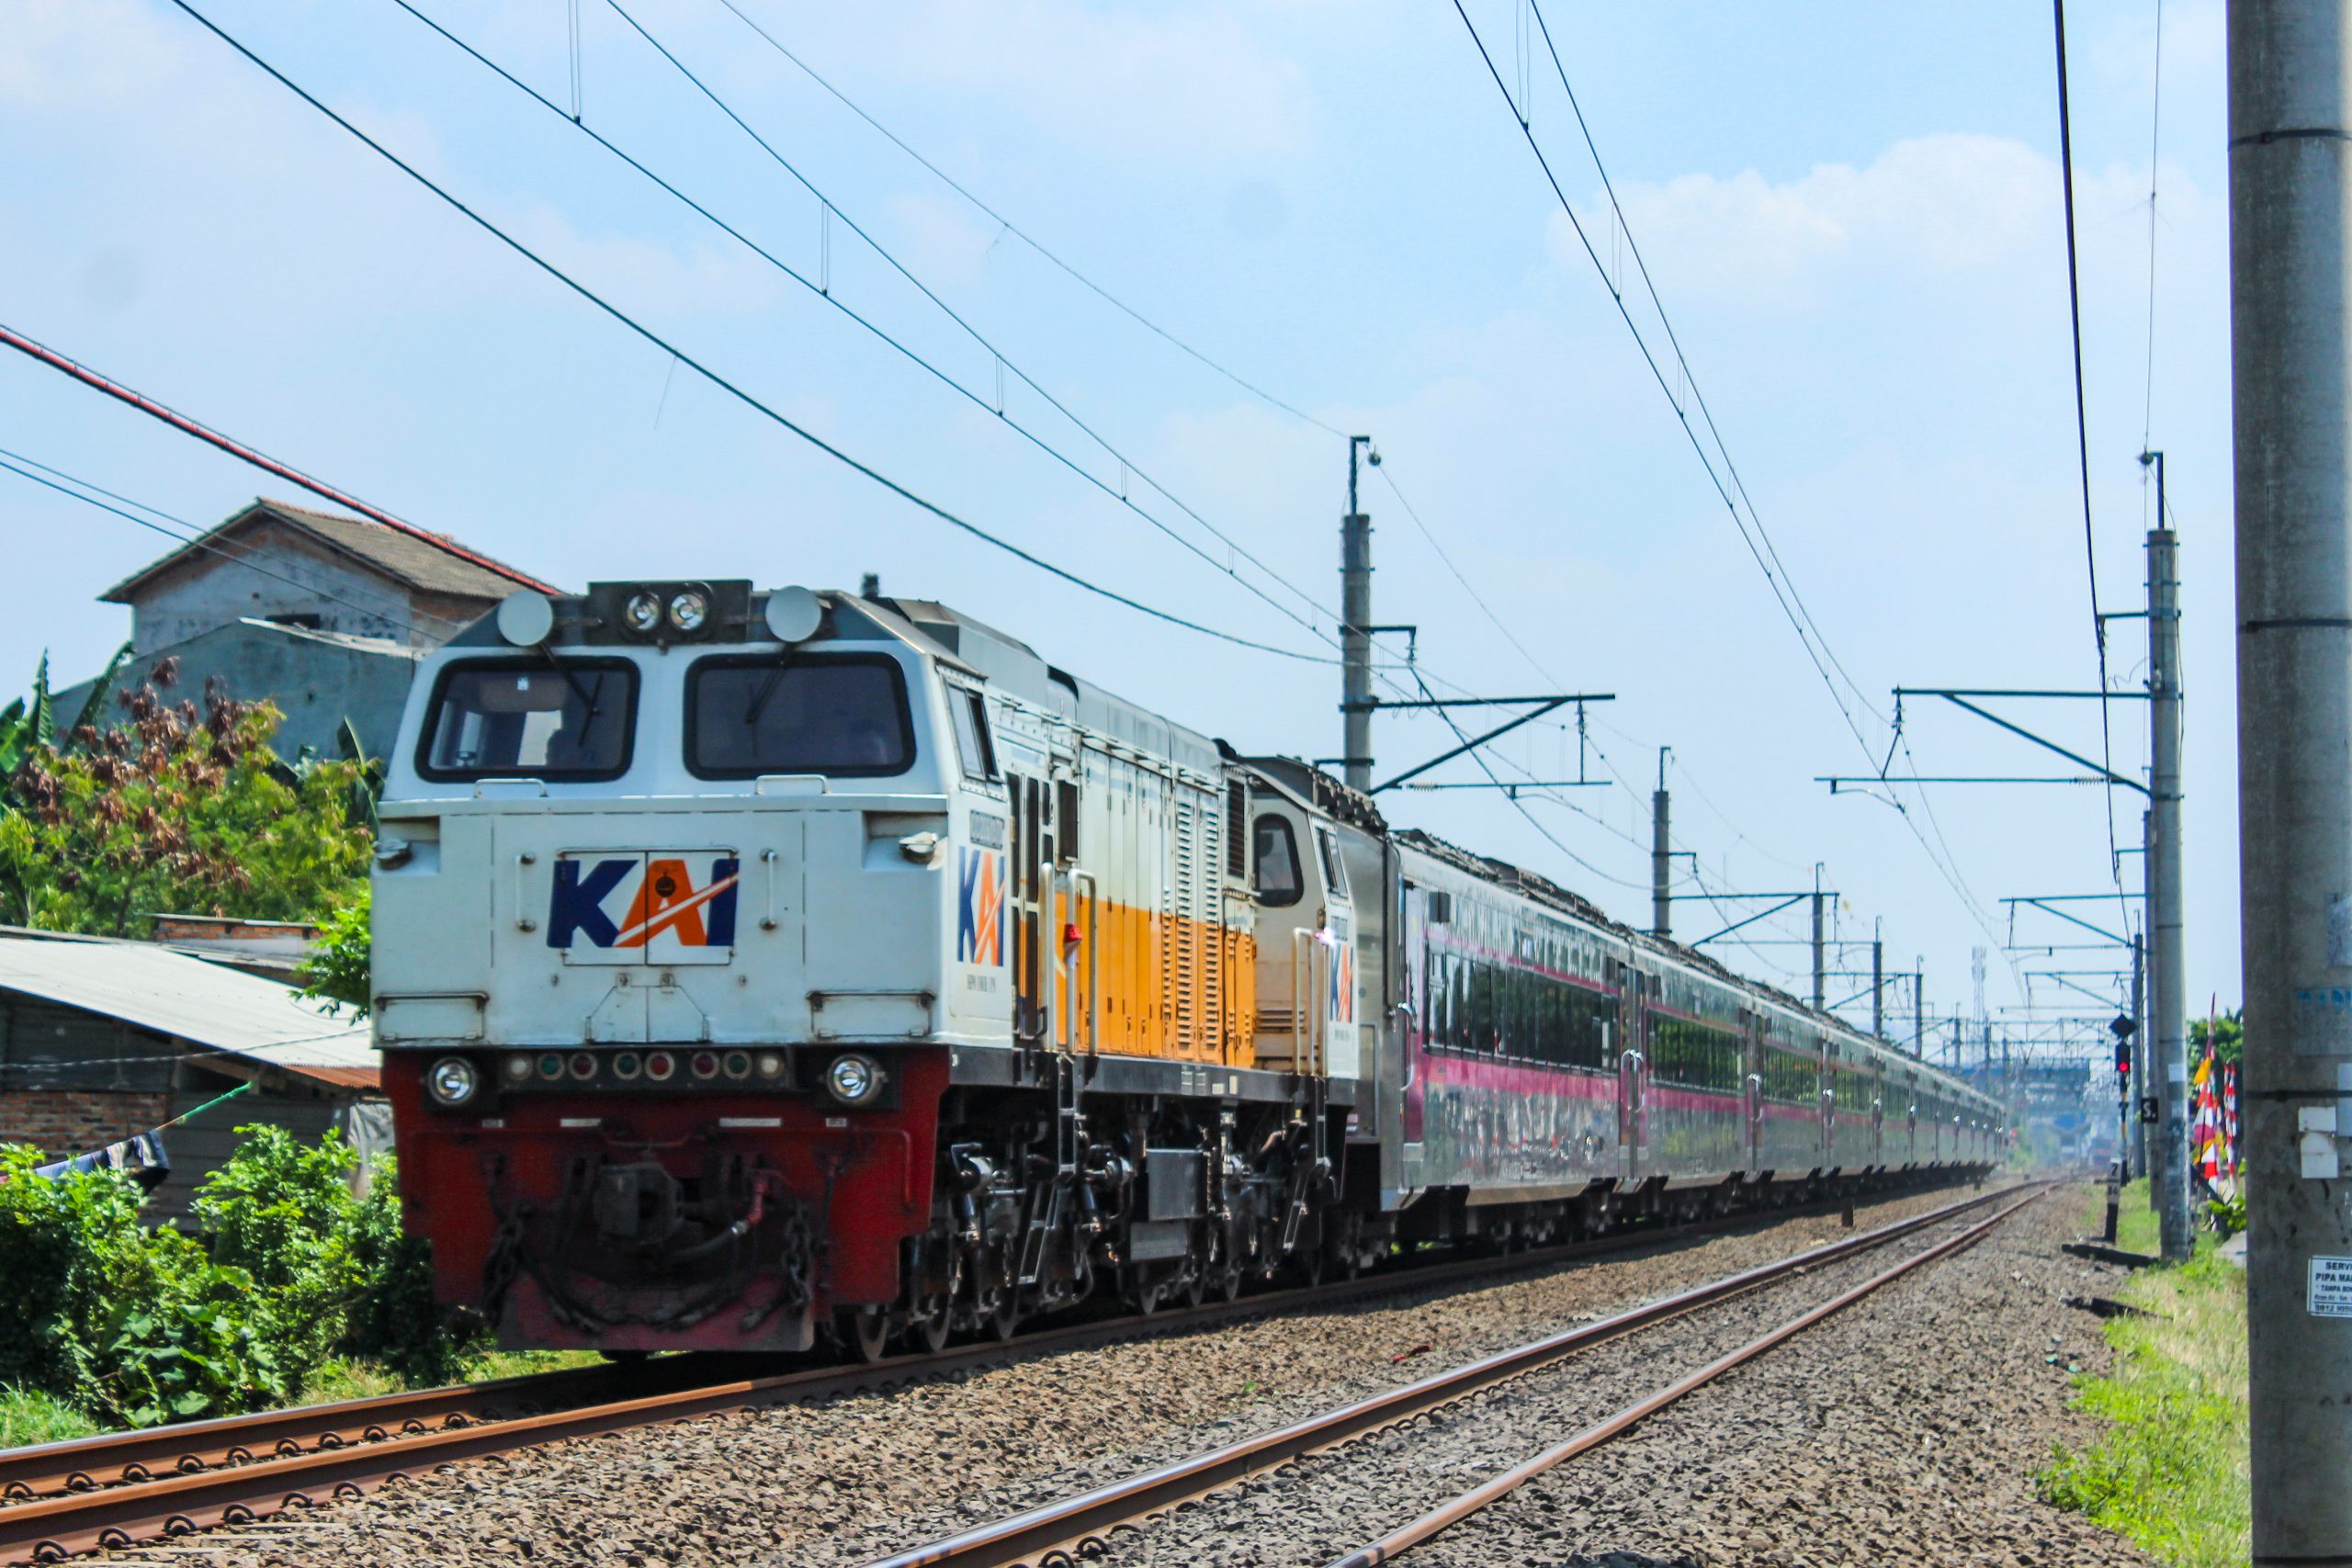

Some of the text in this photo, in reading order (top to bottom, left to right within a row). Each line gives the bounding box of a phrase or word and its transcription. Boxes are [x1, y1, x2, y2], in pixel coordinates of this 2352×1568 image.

[547, 859, 740, 948] KAI
[957, 845, 1005, 966] KAI
[1329, 942, 1352, 1024] KAI
[2315, 1273, 2336, 1281] PIPA
